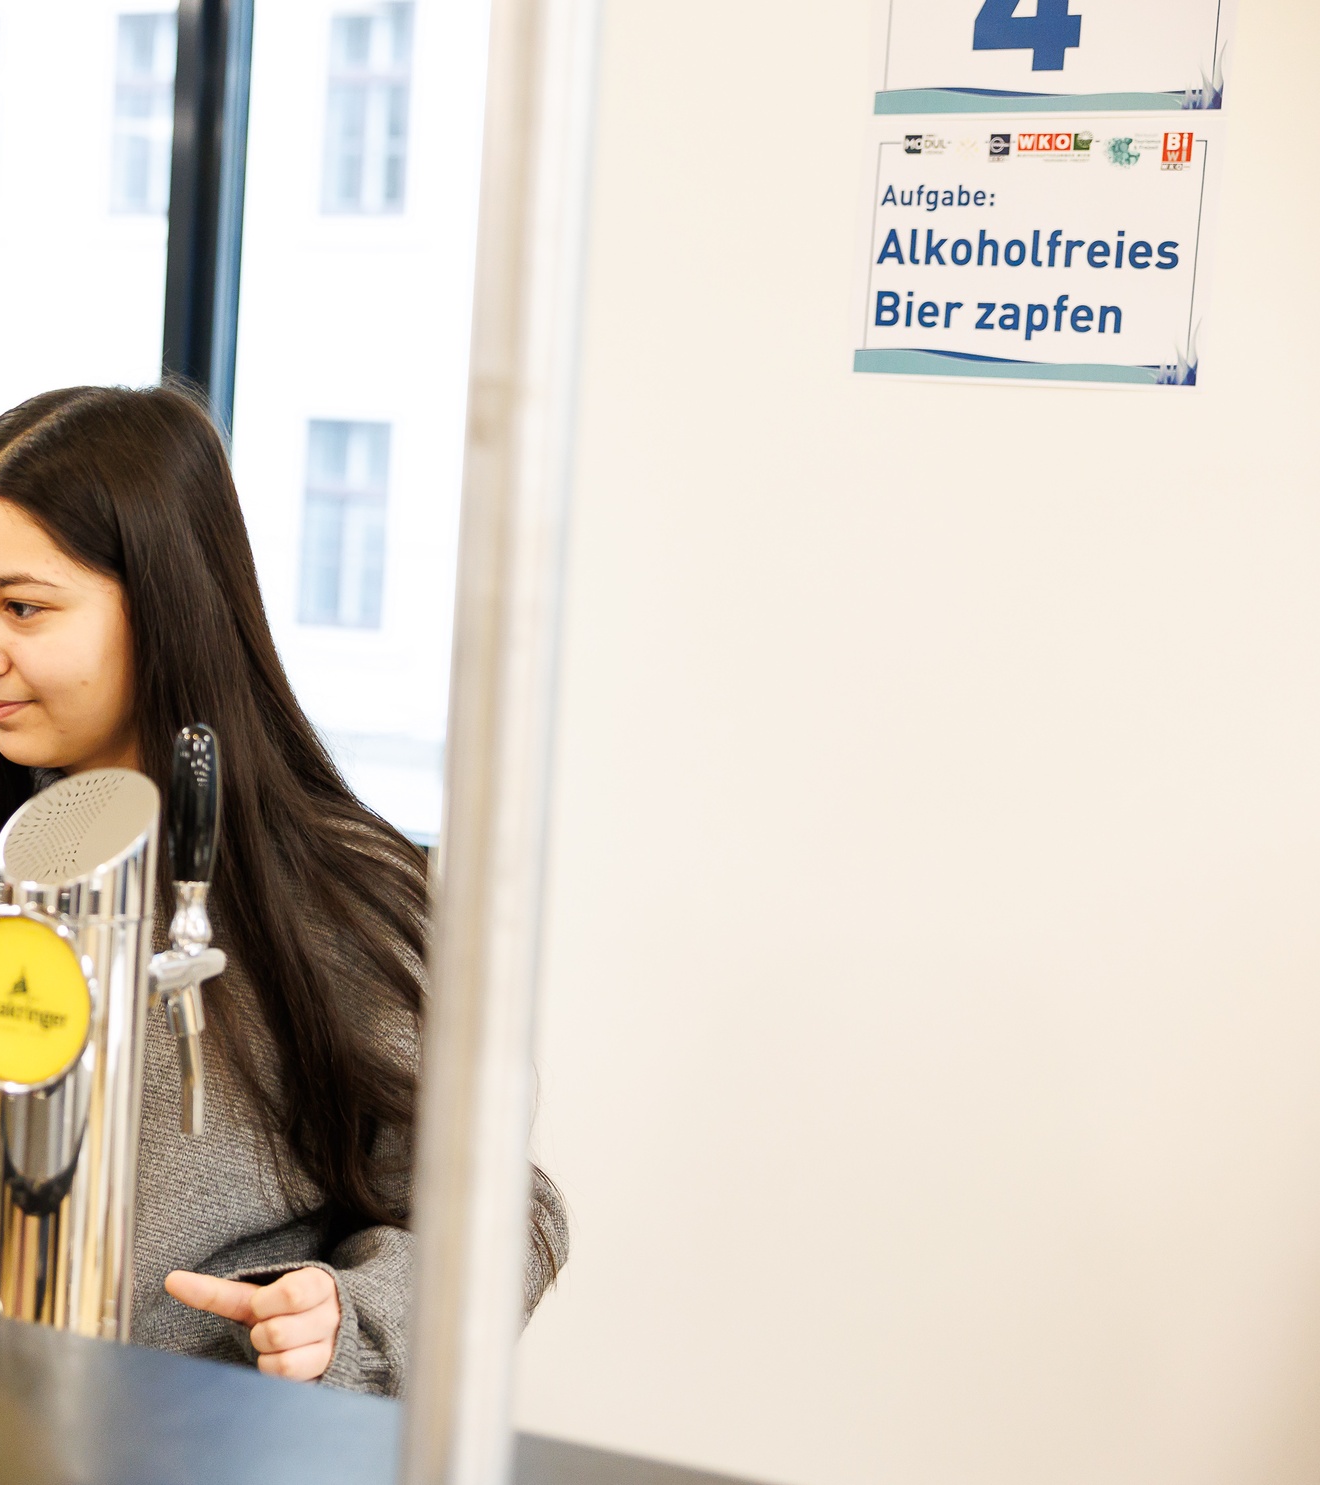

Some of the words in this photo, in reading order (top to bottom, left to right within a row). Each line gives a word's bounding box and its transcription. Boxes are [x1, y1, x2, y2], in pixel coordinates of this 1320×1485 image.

[1018, 133, 1072, 151] WKO
[881, 185, 995, 211] Aufgabe:
[876, 228, 1180, 270] Alkoholfreies
[874, 290, 963, 328] Bier
[974, 294, 1123, 341] zapfen
